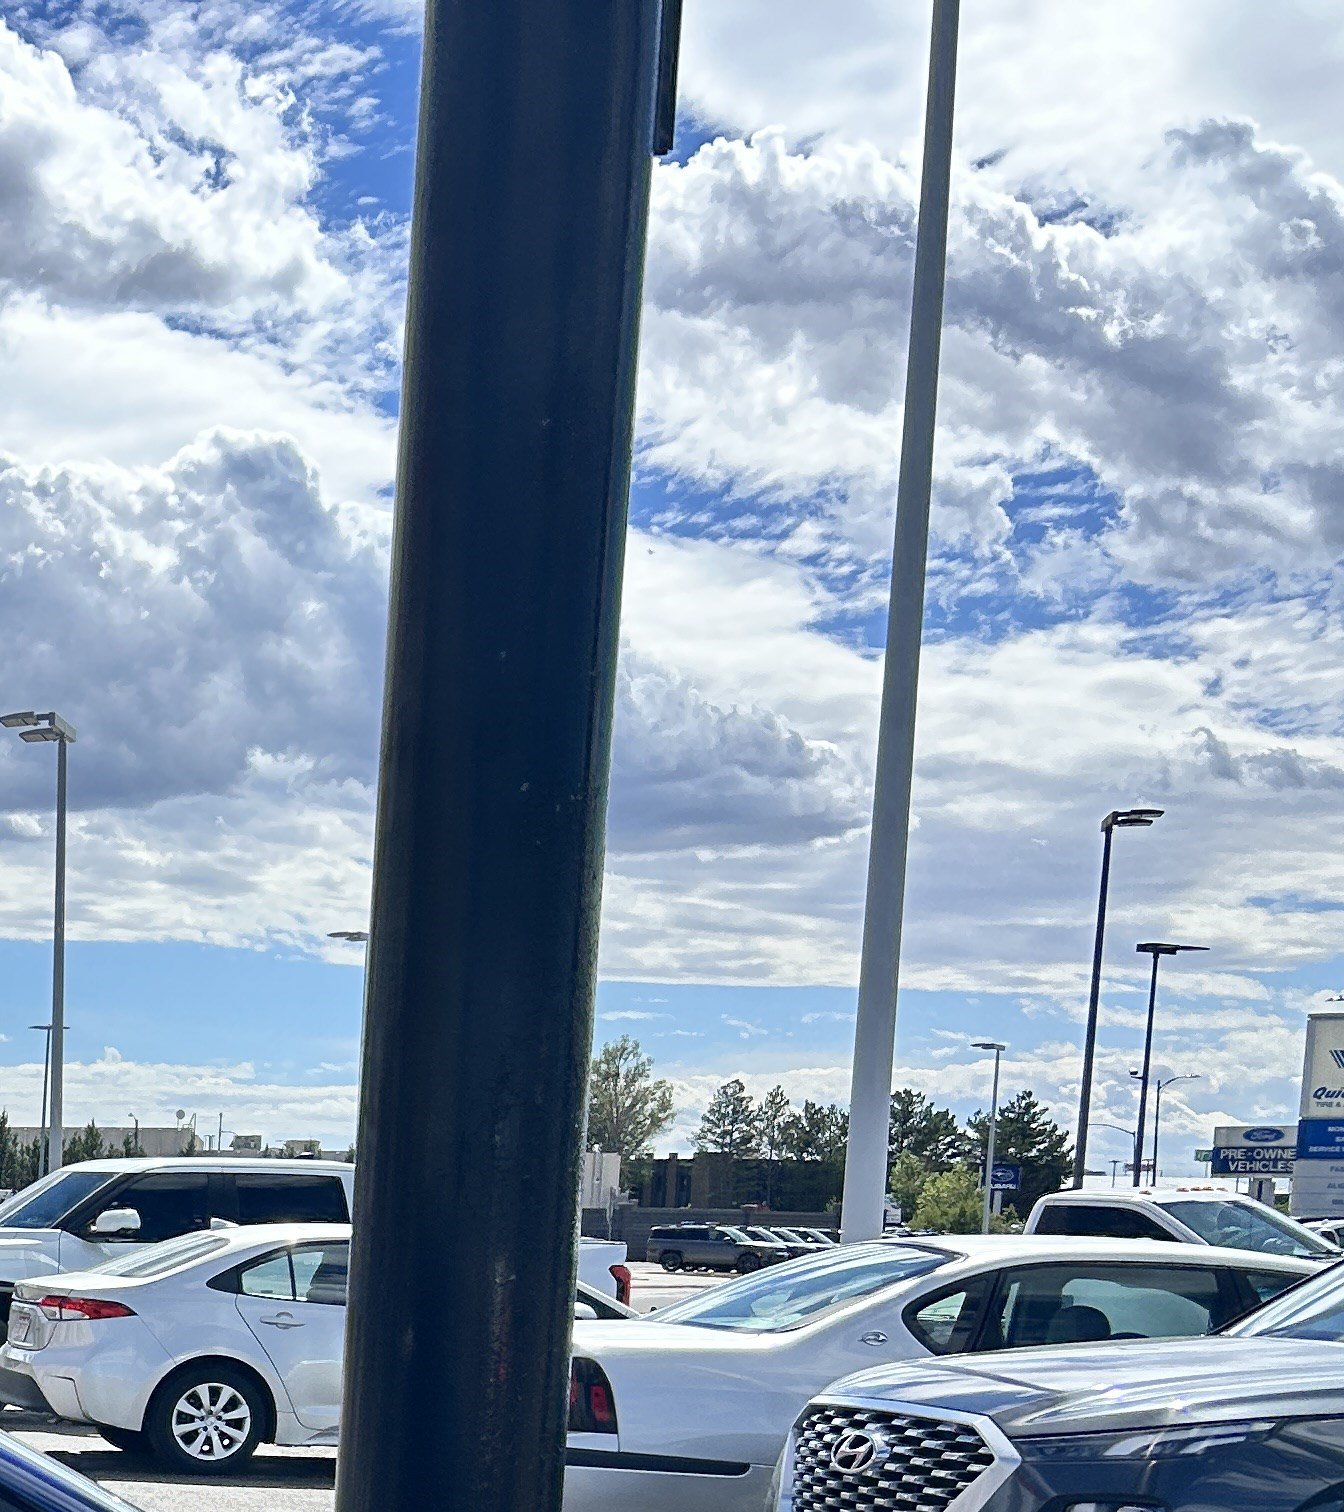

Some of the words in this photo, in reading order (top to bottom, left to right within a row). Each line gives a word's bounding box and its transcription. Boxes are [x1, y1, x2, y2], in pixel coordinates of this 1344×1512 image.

[1312, 1086, 1344, 1099] Qui
[1220, 1148, 1297, 1160] PRE-OWNE
[1229, 1160, 1294, 1172] VEHICLES
